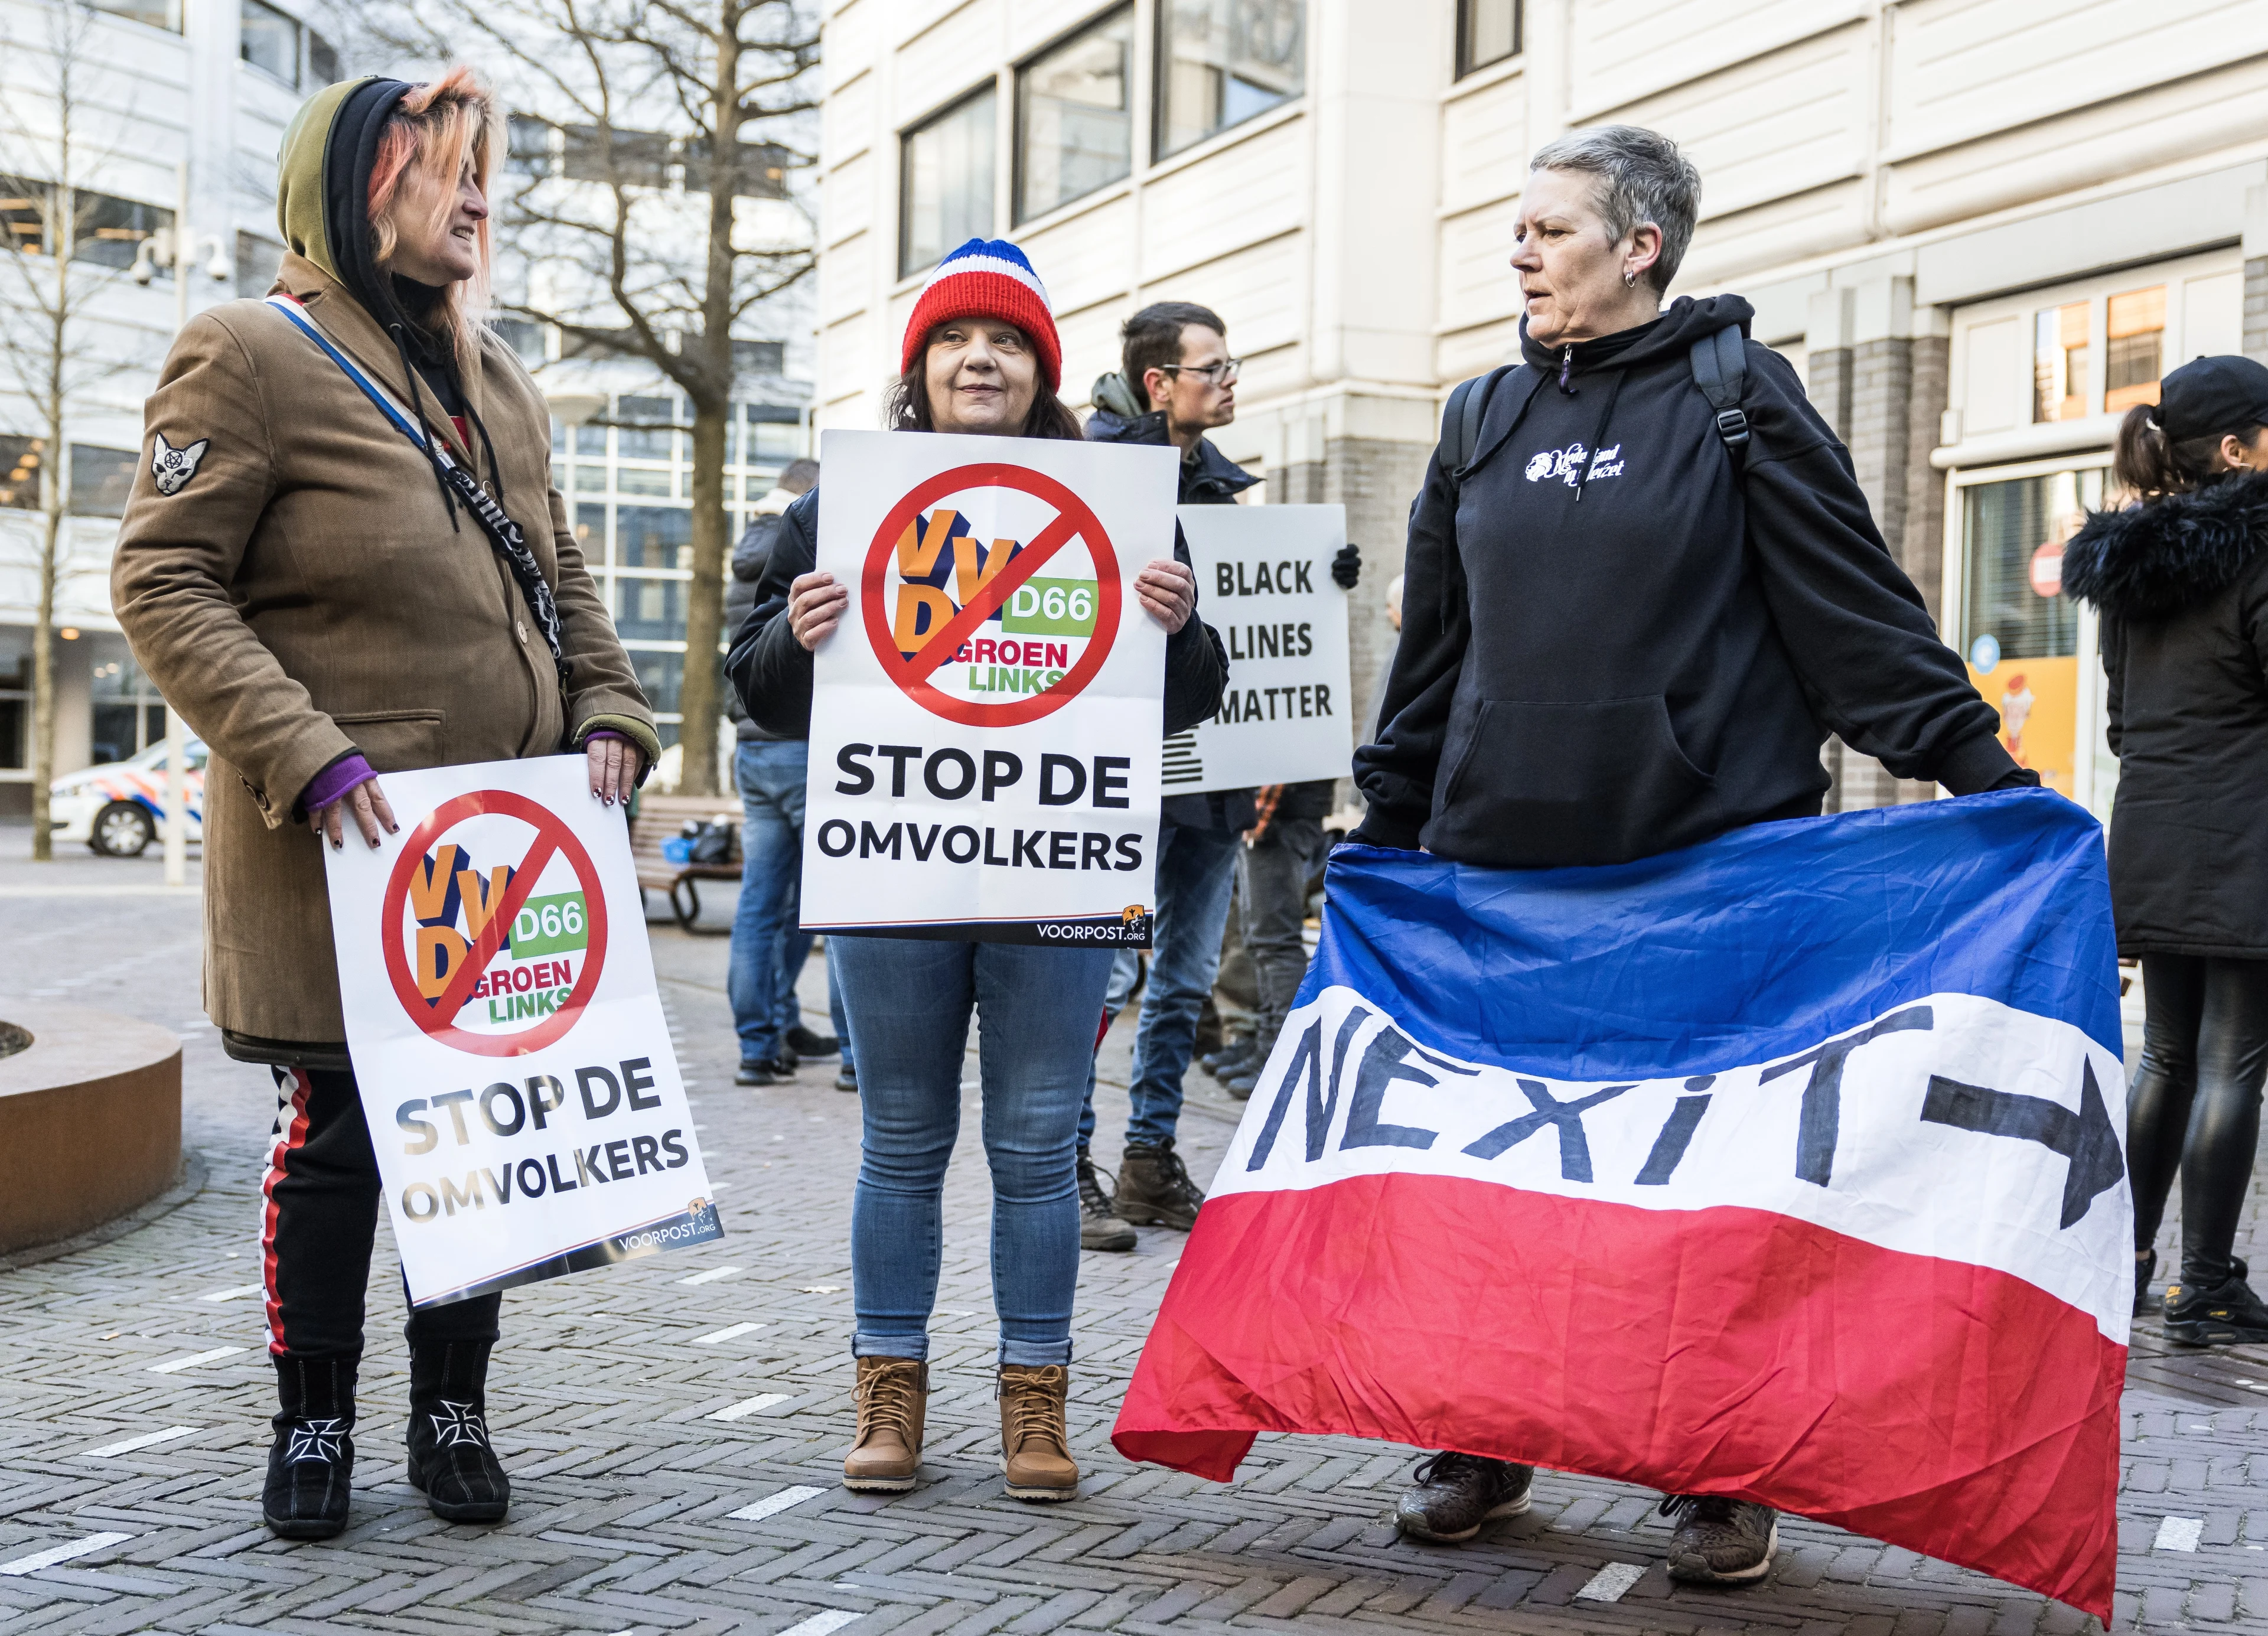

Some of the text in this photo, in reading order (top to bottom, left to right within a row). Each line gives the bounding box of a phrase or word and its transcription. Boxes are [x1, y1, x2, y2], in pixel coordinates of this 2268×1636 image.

[1216, 560, 1314, 597] BLACK
[1011, 584, 1091, 621] D66
[953, 638, 1068, 669] GROEN
[1230, 623, 1313, 660] LINES
[969, 666, 1065, 695] LINKS
[1214, 684, 1334, 725] MATTER
[835, 743, 1130, 809] STOP DE
[817, 819, 1143, 871] OMVOLKERS
[514, 901, 583, 943] D66
[1037, 924, 1146, 941] VOORPOST.ORG
[472, 959, 572, 999] GROEN
[488, 987, 572, 1025] LINKS
[396, 1057, 662, 1155] STOP DE
[401, 1129, 689, 1223] OMVOLKERS
[618, 1222, 716, 1252] VOORPOST.ORG
